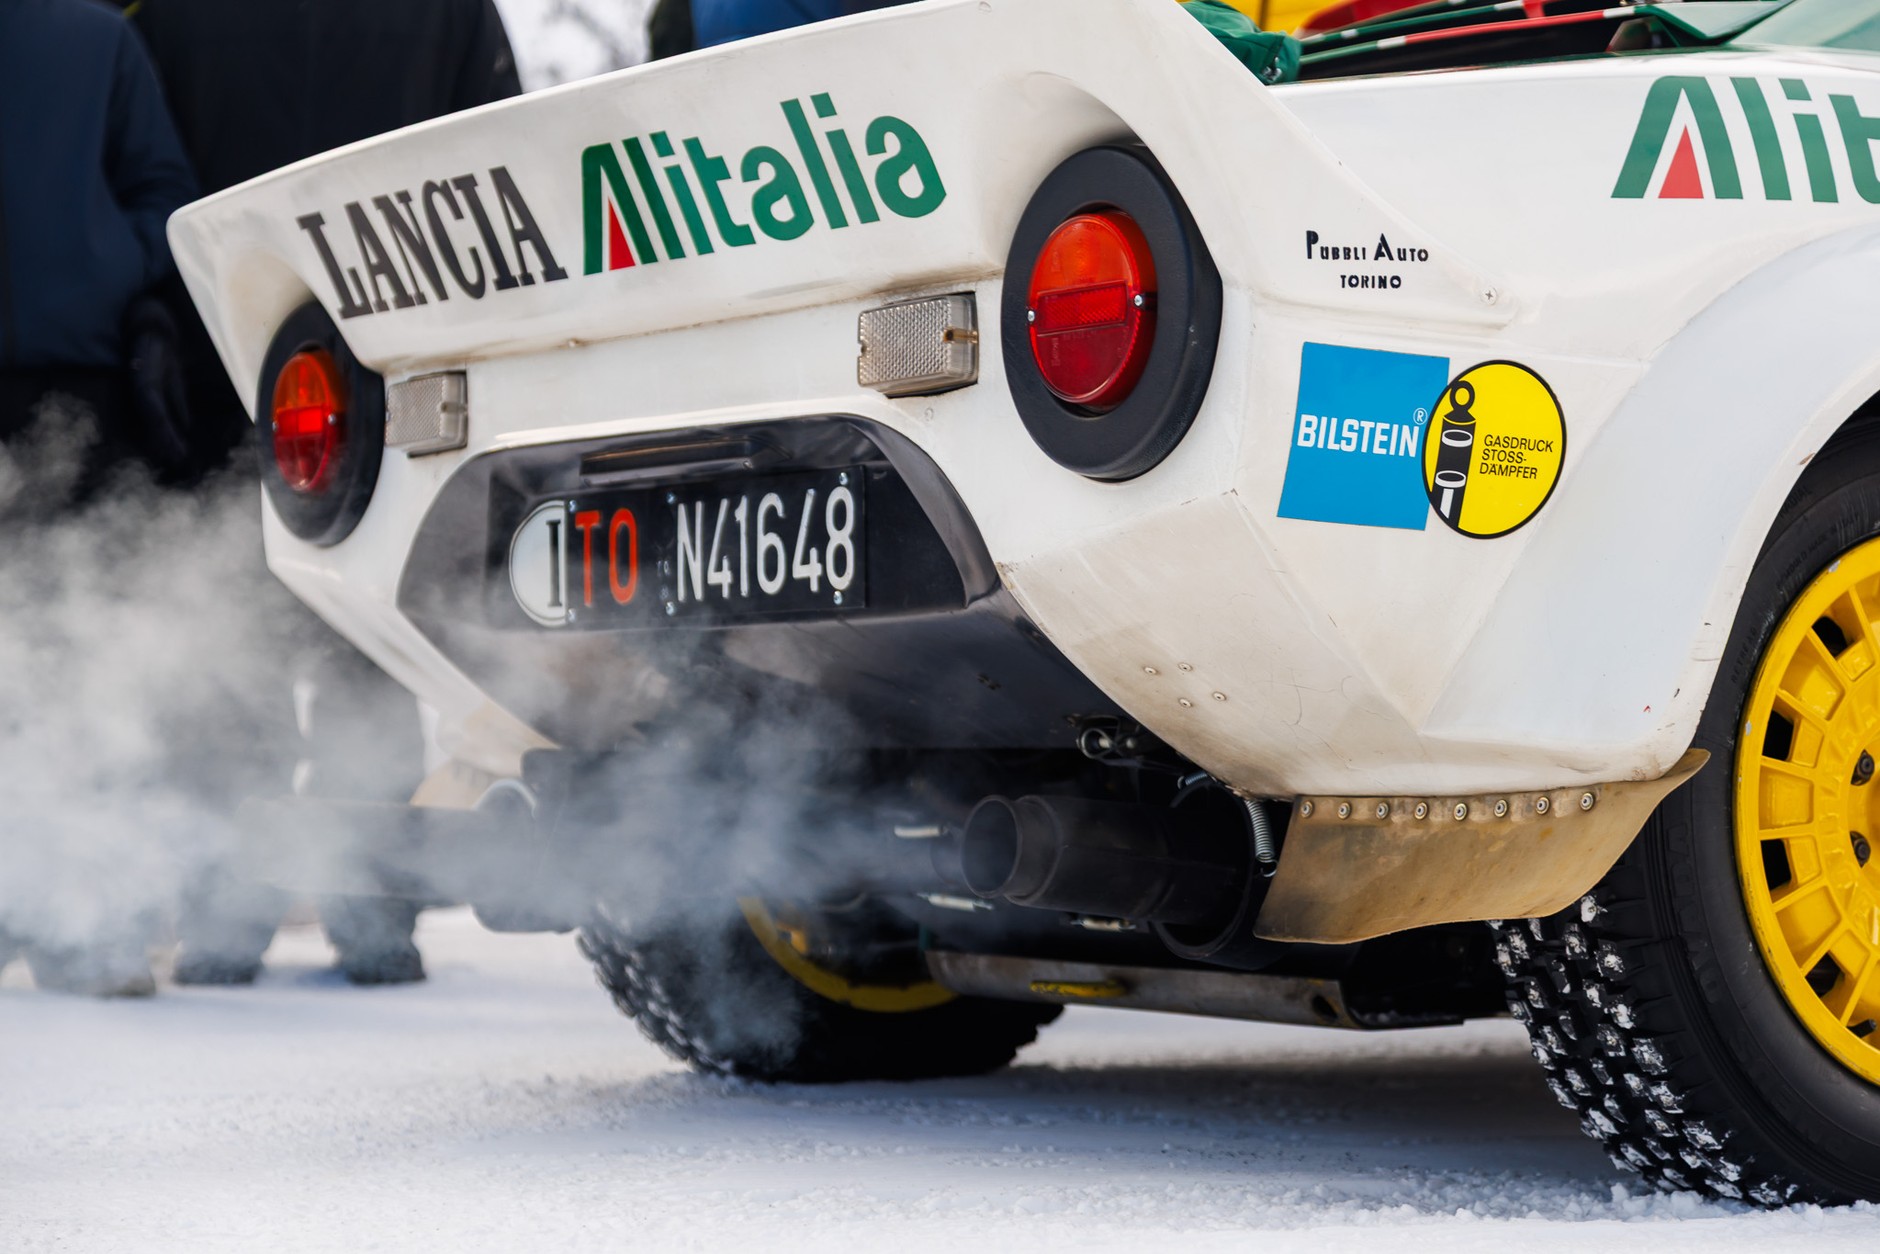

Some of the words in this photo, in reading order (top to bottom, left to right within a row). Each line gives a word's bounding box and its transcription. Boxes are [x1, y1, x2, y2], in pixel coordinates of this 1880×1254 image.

[296, 165, 568, 320] LANCIA
[581, 92, 947, 275] Alitalia
[1374, 233, 1429, 262] AUTO
[1340, 275, 1402, 289] TORINO
[1297, 414, 1420, 458] BILSTEIN
[1483, 434, 1554, 453] GASDRUCK
[1481, 449, 1527, 464] STOSS-
[1479, 461, 1538, 480] DÄMPFER
[575, 508, 639, 608] TO
[677, 486, 855, 602] N41648
